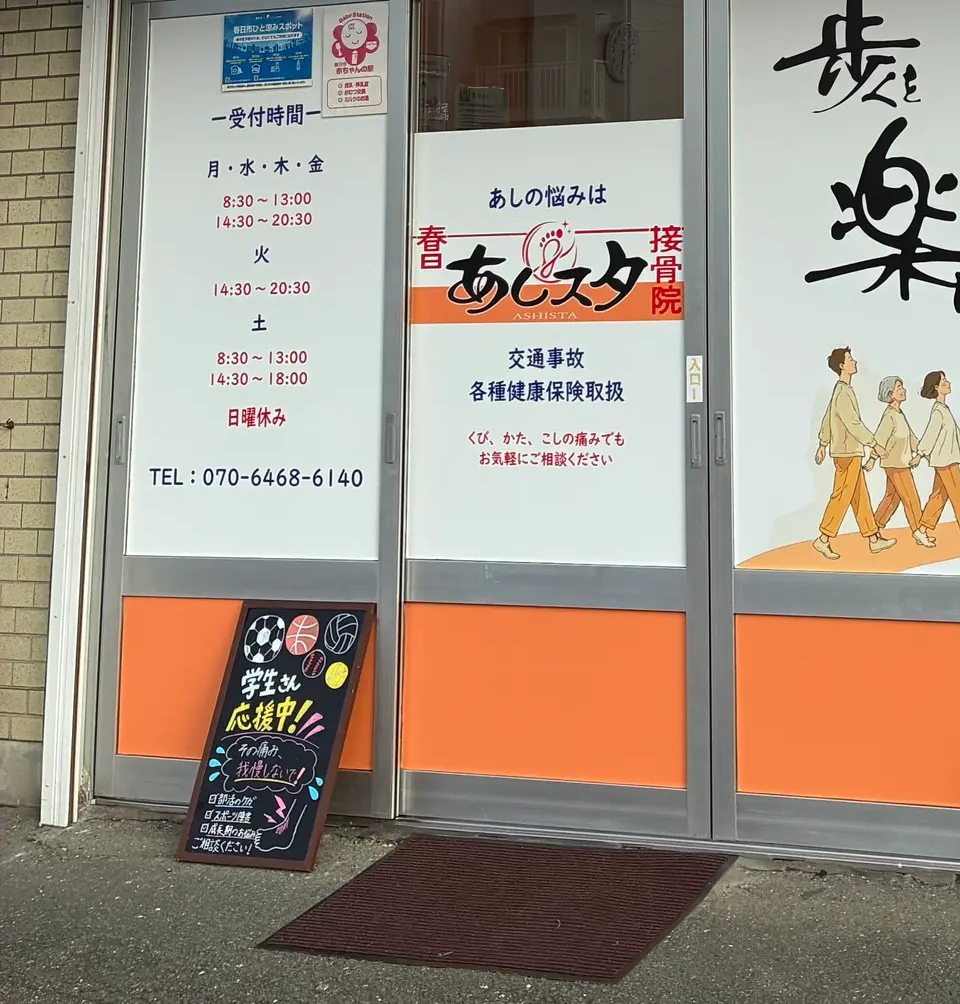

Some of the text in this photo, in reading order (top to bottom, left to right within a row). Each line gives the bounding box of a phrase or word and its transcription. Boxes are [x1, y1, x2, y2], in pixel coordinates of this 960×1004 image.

[207, 154, 324, 178] 月・水・木・金
[488, 184, 607, 209] あしの悩みは
[253, 245, 270, 264] 火
[416, 225, 447, 270] 春日
[446, 240, 648, 314] あしスタ
[650, 225, 684, 315] 接骨院
[251, 314, 267, 332] 土
[513, 311, 578, 320] ASHISTA
[508, 348, 585, 370] 交通事故
[689, 358, 701, 385] 入口
[469, 380, 625, 403] 各種健康保険取扱
[227, 407, 286, 428] 日曜休み
[468, 431, 625, 447] くび、かた、こしの痛みでも
[479, 451, 613, 467] お気軽にご相談ください
[240, 667, 302, 700] 学生さん
